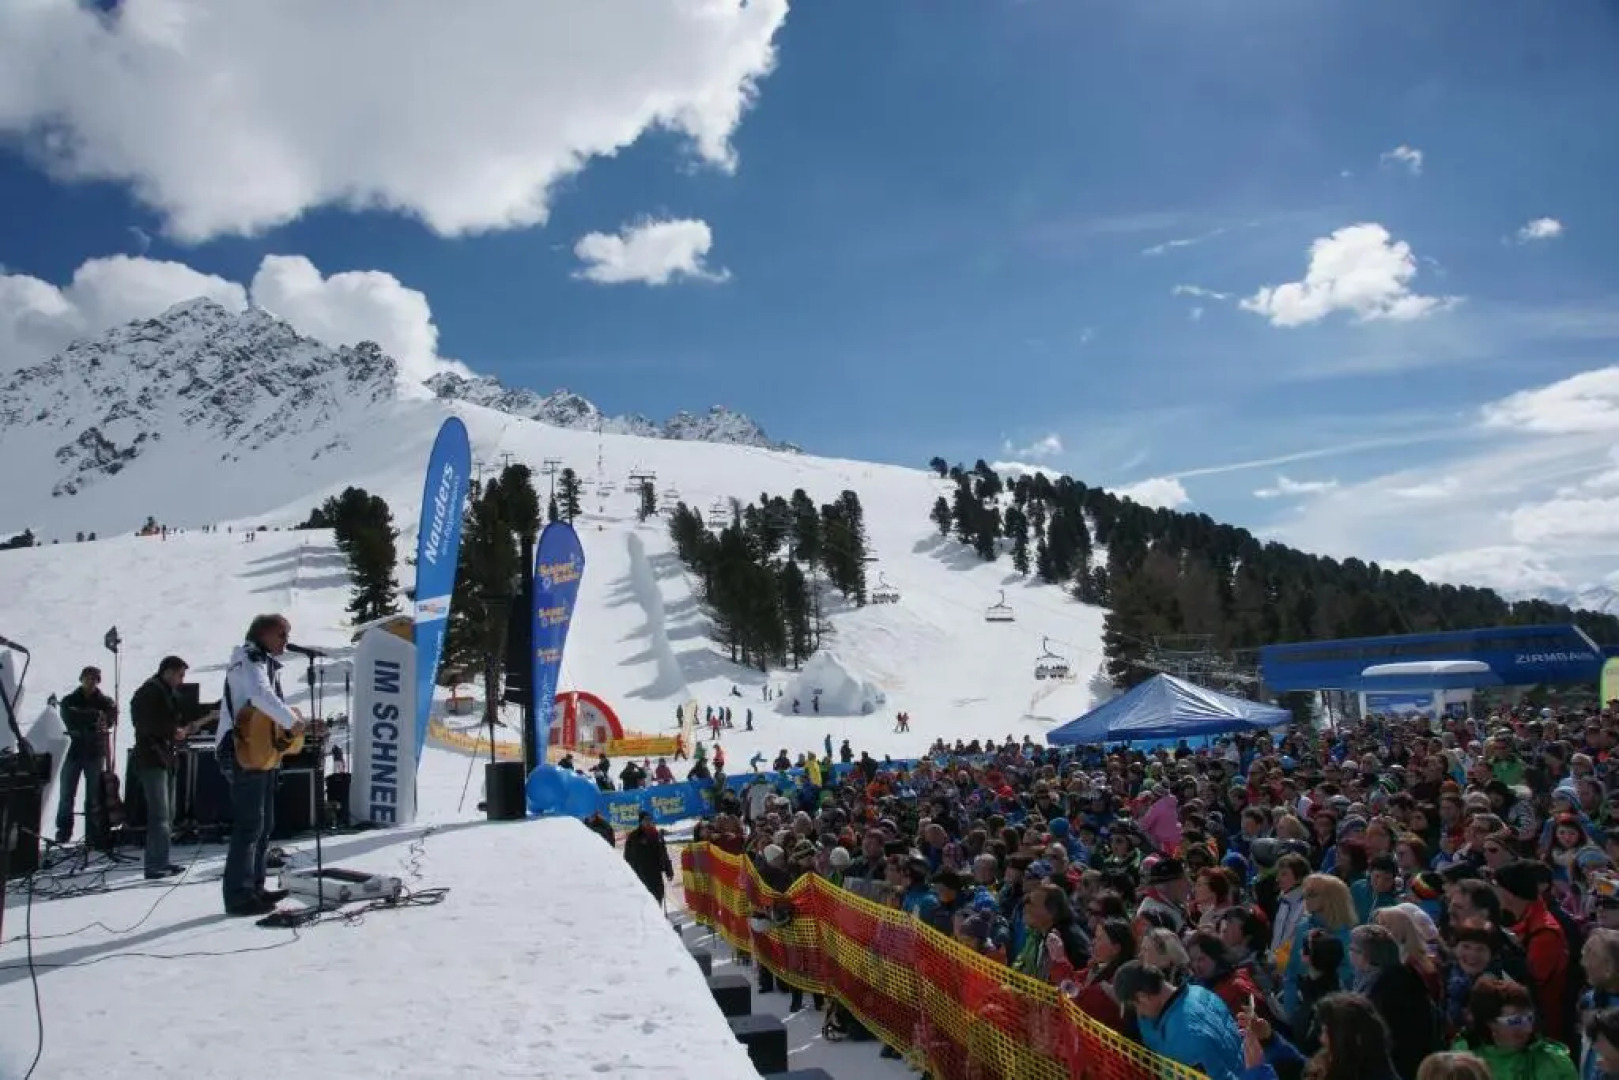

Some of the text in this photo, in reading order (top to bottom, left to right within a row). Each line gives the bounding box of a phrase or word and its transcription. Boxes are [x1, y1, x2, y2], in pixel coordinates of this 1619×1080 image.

[424, 461, 454, 565] Nauders
[369, 659, 401, 823] IM SCHNEE
